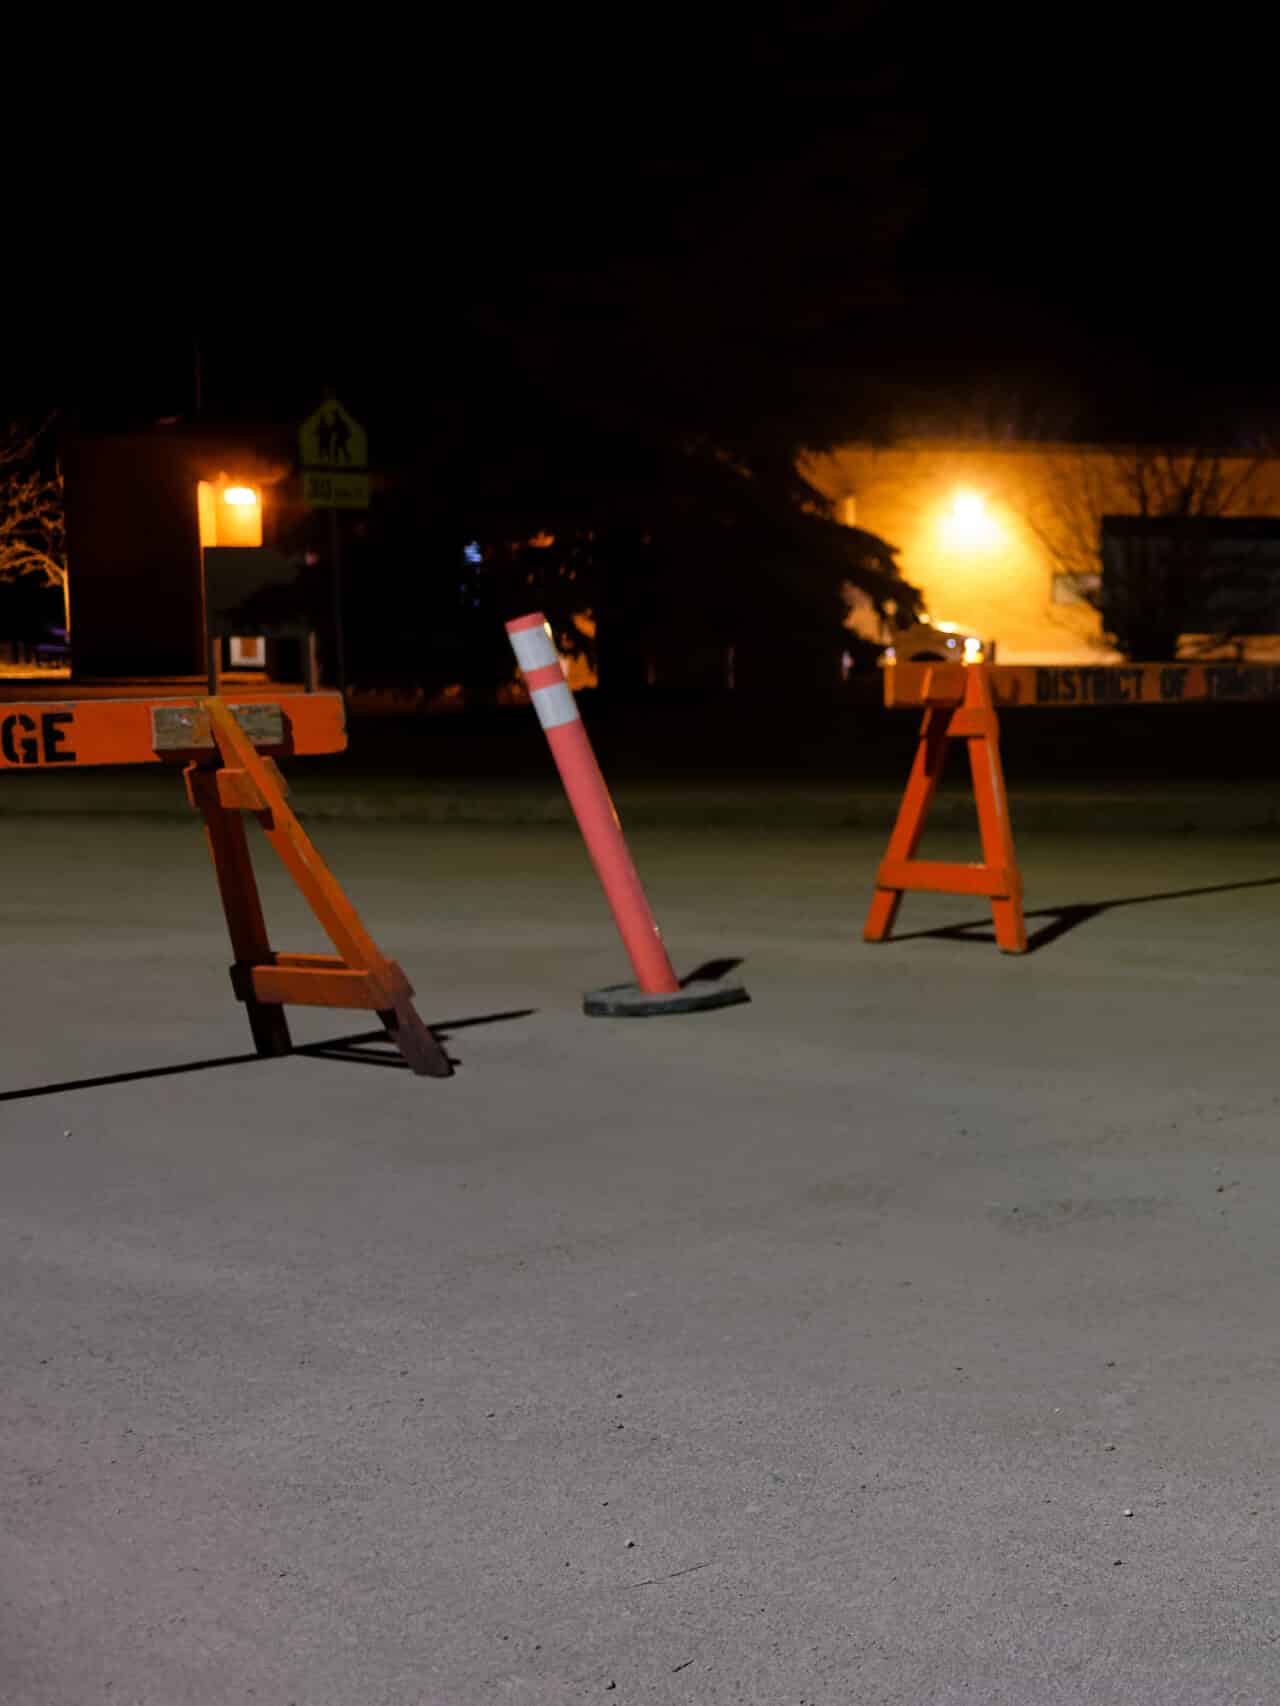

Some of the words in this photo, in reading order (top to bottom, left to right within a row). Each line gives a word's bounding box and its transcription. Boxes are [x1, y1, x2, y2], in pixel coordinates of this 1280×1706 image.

[1036, 668, 1144, 702] DISTRICT
[1160, 668, 1189, 701] OF
[2, 713, 76, 763] GE
